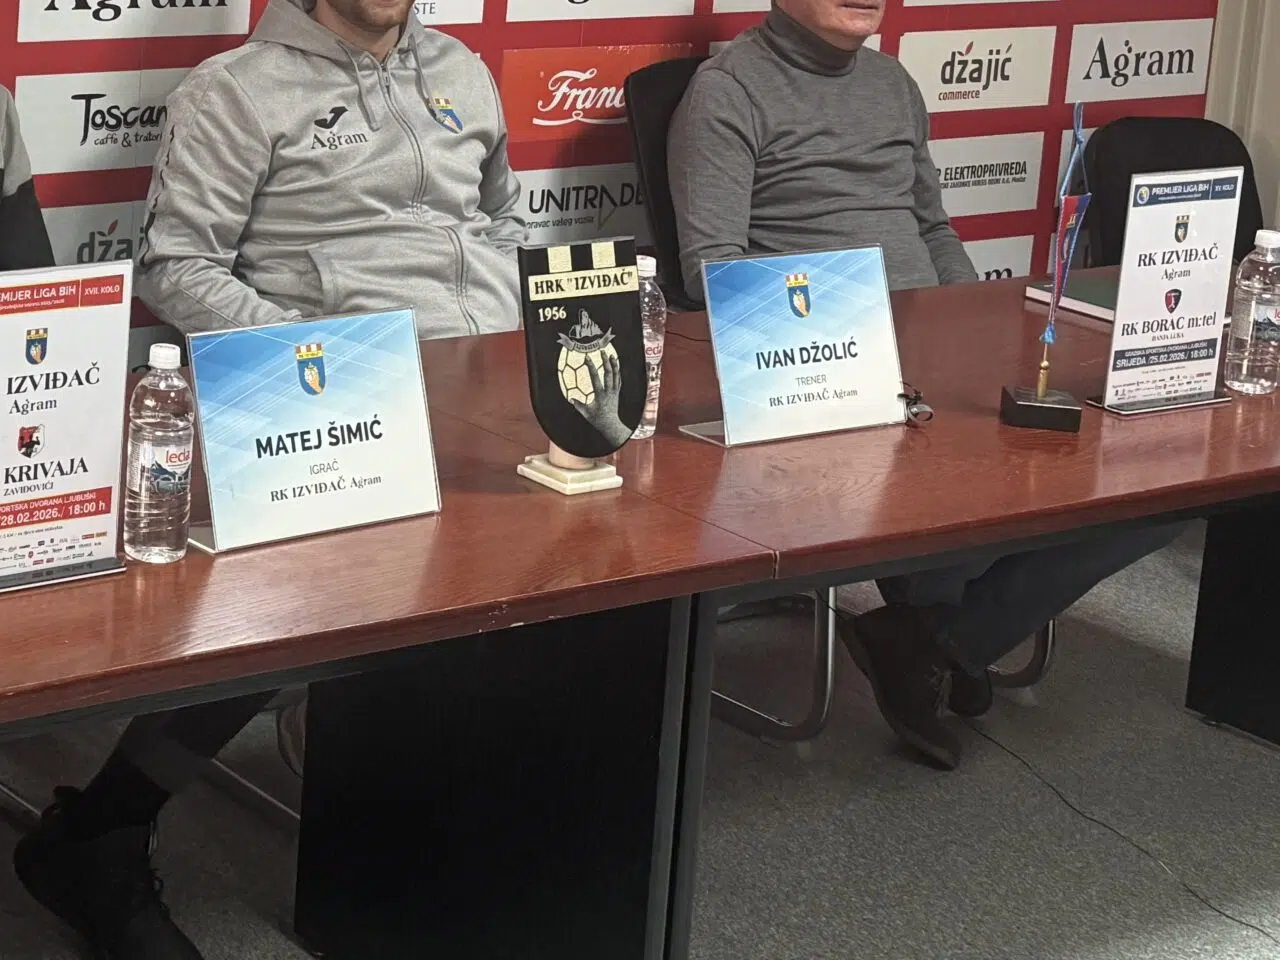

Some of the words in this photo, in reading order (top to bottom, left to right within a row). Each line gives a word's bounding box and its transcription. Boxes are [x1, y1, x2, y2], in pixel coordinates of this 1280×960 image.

[940, 41, 1013, 90] džajić
[1083, 36, 1195, 87] Agram
[938, 90, 980, 101] commerce
[121, 132, 132, 147] &
[311, 131, 368, 150] Agram
[943, 161, 1027, 181] ELEKTROPRIVREDA
[1152, 185, 1182, 196] PREMIJER
[1183, 183, 1198, 192] LIGA
[1137, 252, 1158, 267] RK
[1161, 243, 1218, 264] IZVIĐAČ
[1161, 268, 1191, 281] Agram
[33, 287, 57, 299] LIGA
[59, 285, 76, 296] BiH
[101, 284, 120, 294] KOLO
[534, 278, 564, 294] HRK
[538, 306, 567, 322] 1956
[1121, 321, 1139, 336] RK
[1142, 316, 1185, 334] BORAC
[1188, 311, 1216, 328] m:tel
[756, 348, 796, 370] IVAN
[799, 336, 858, 365] DŽOLIĆ
[1116, 355, 1146, 368] SRIJEDA
[1190, 348, 1208, 358] 18:00
[6, 361, 100, 395] IZVIĐAČ
[796, 374, 827, 387] TRENER
[769, 395, 784, 407] RK
[786, 387, 830, 405] IZVIĐAČ
[832, 388, 858, 400] Agram
[9, 398, 57, 415] Agram
[255, 429, 323, 459] MATEJ
[327, 414, 383, 447] ŠIMIĆ
[165, 446, 190, 464] leda
[3, 457, 89, 484] KRIVAJA
[310, 458, 339, 476] IGRAČ
[3, 482, 54, 496] ZAVIDOVIĆI
[270, 488, 289, 502] RK
[292, 476, 346, 498] IZVIĐAČ
[350, 474, 382, 489] Agram
[30, 498, 63, 509] DVORANA
[64, 492, 96, 504] LJUBUŠKI
[68, 502, 96, 515] 18:00
[98, 501, 105, 510] h
